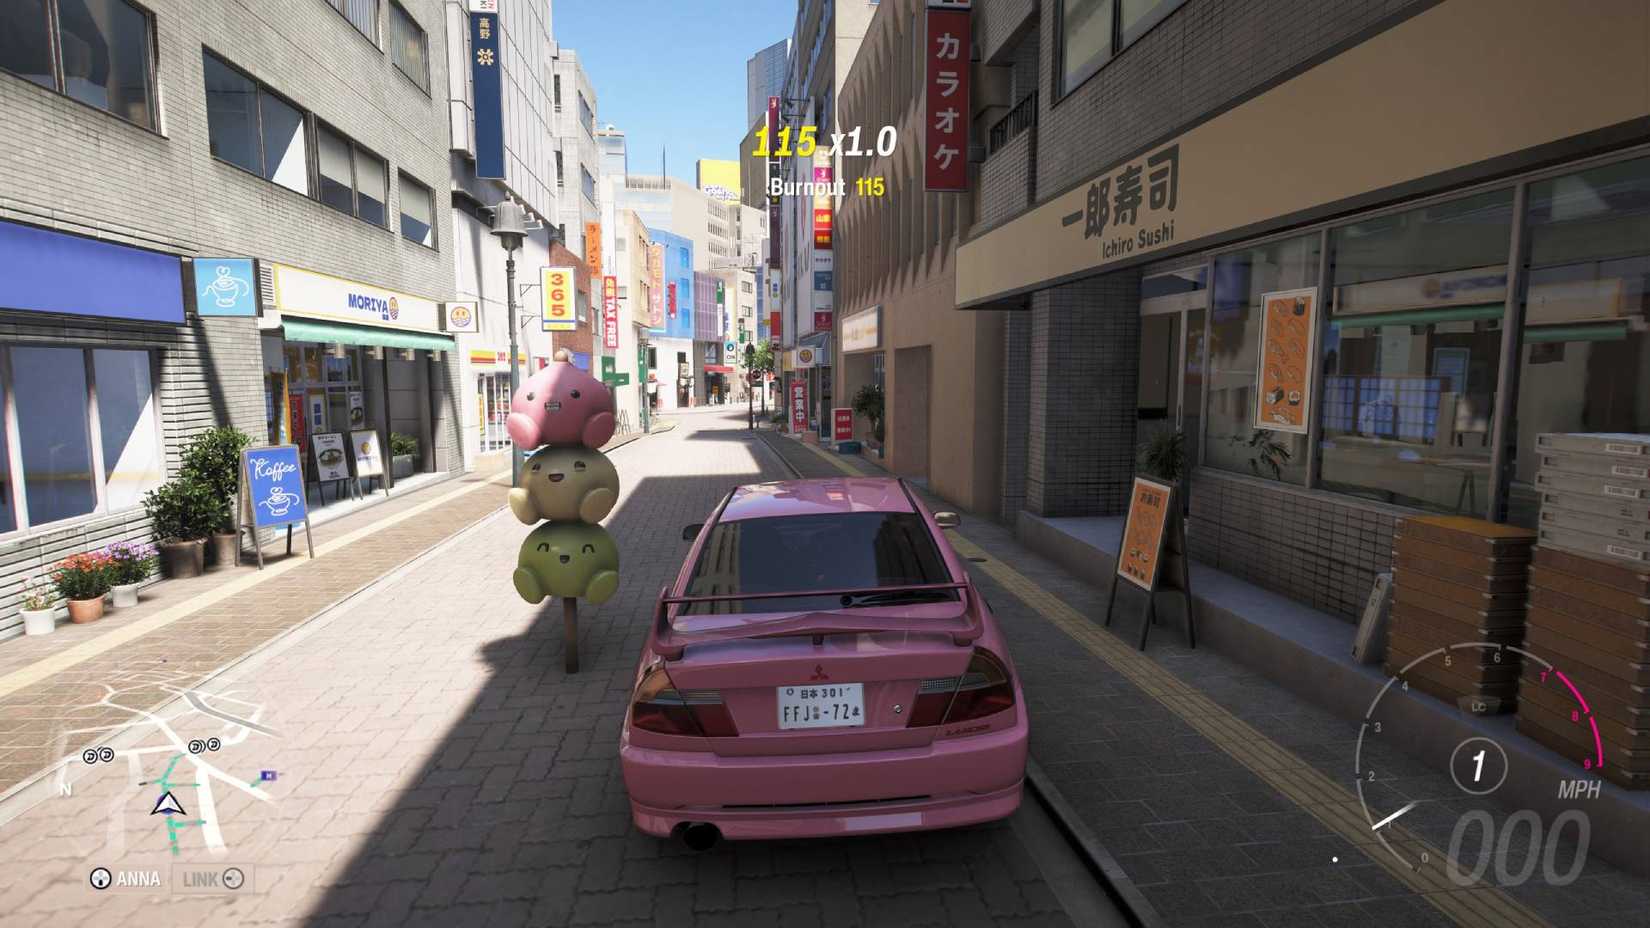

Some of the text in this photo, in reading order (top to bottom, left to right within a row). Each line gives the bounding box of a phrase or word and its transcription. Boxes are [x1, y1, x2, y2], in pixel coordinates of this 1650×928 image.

[933, 32, 960, 170] カラオケ
[1062, 143, 1180, 240] 一郎寿司
[1102, 219, 1175, 259] Ichiro Sushi
[348, 293, 389, 313] MORIYA
[551, 273, 565, 317] 365
[606, 299, 617, 347] TAX FREE
[250, 458, 296, 482] Koffee
[801, 687, 844, 699] 日本 301
